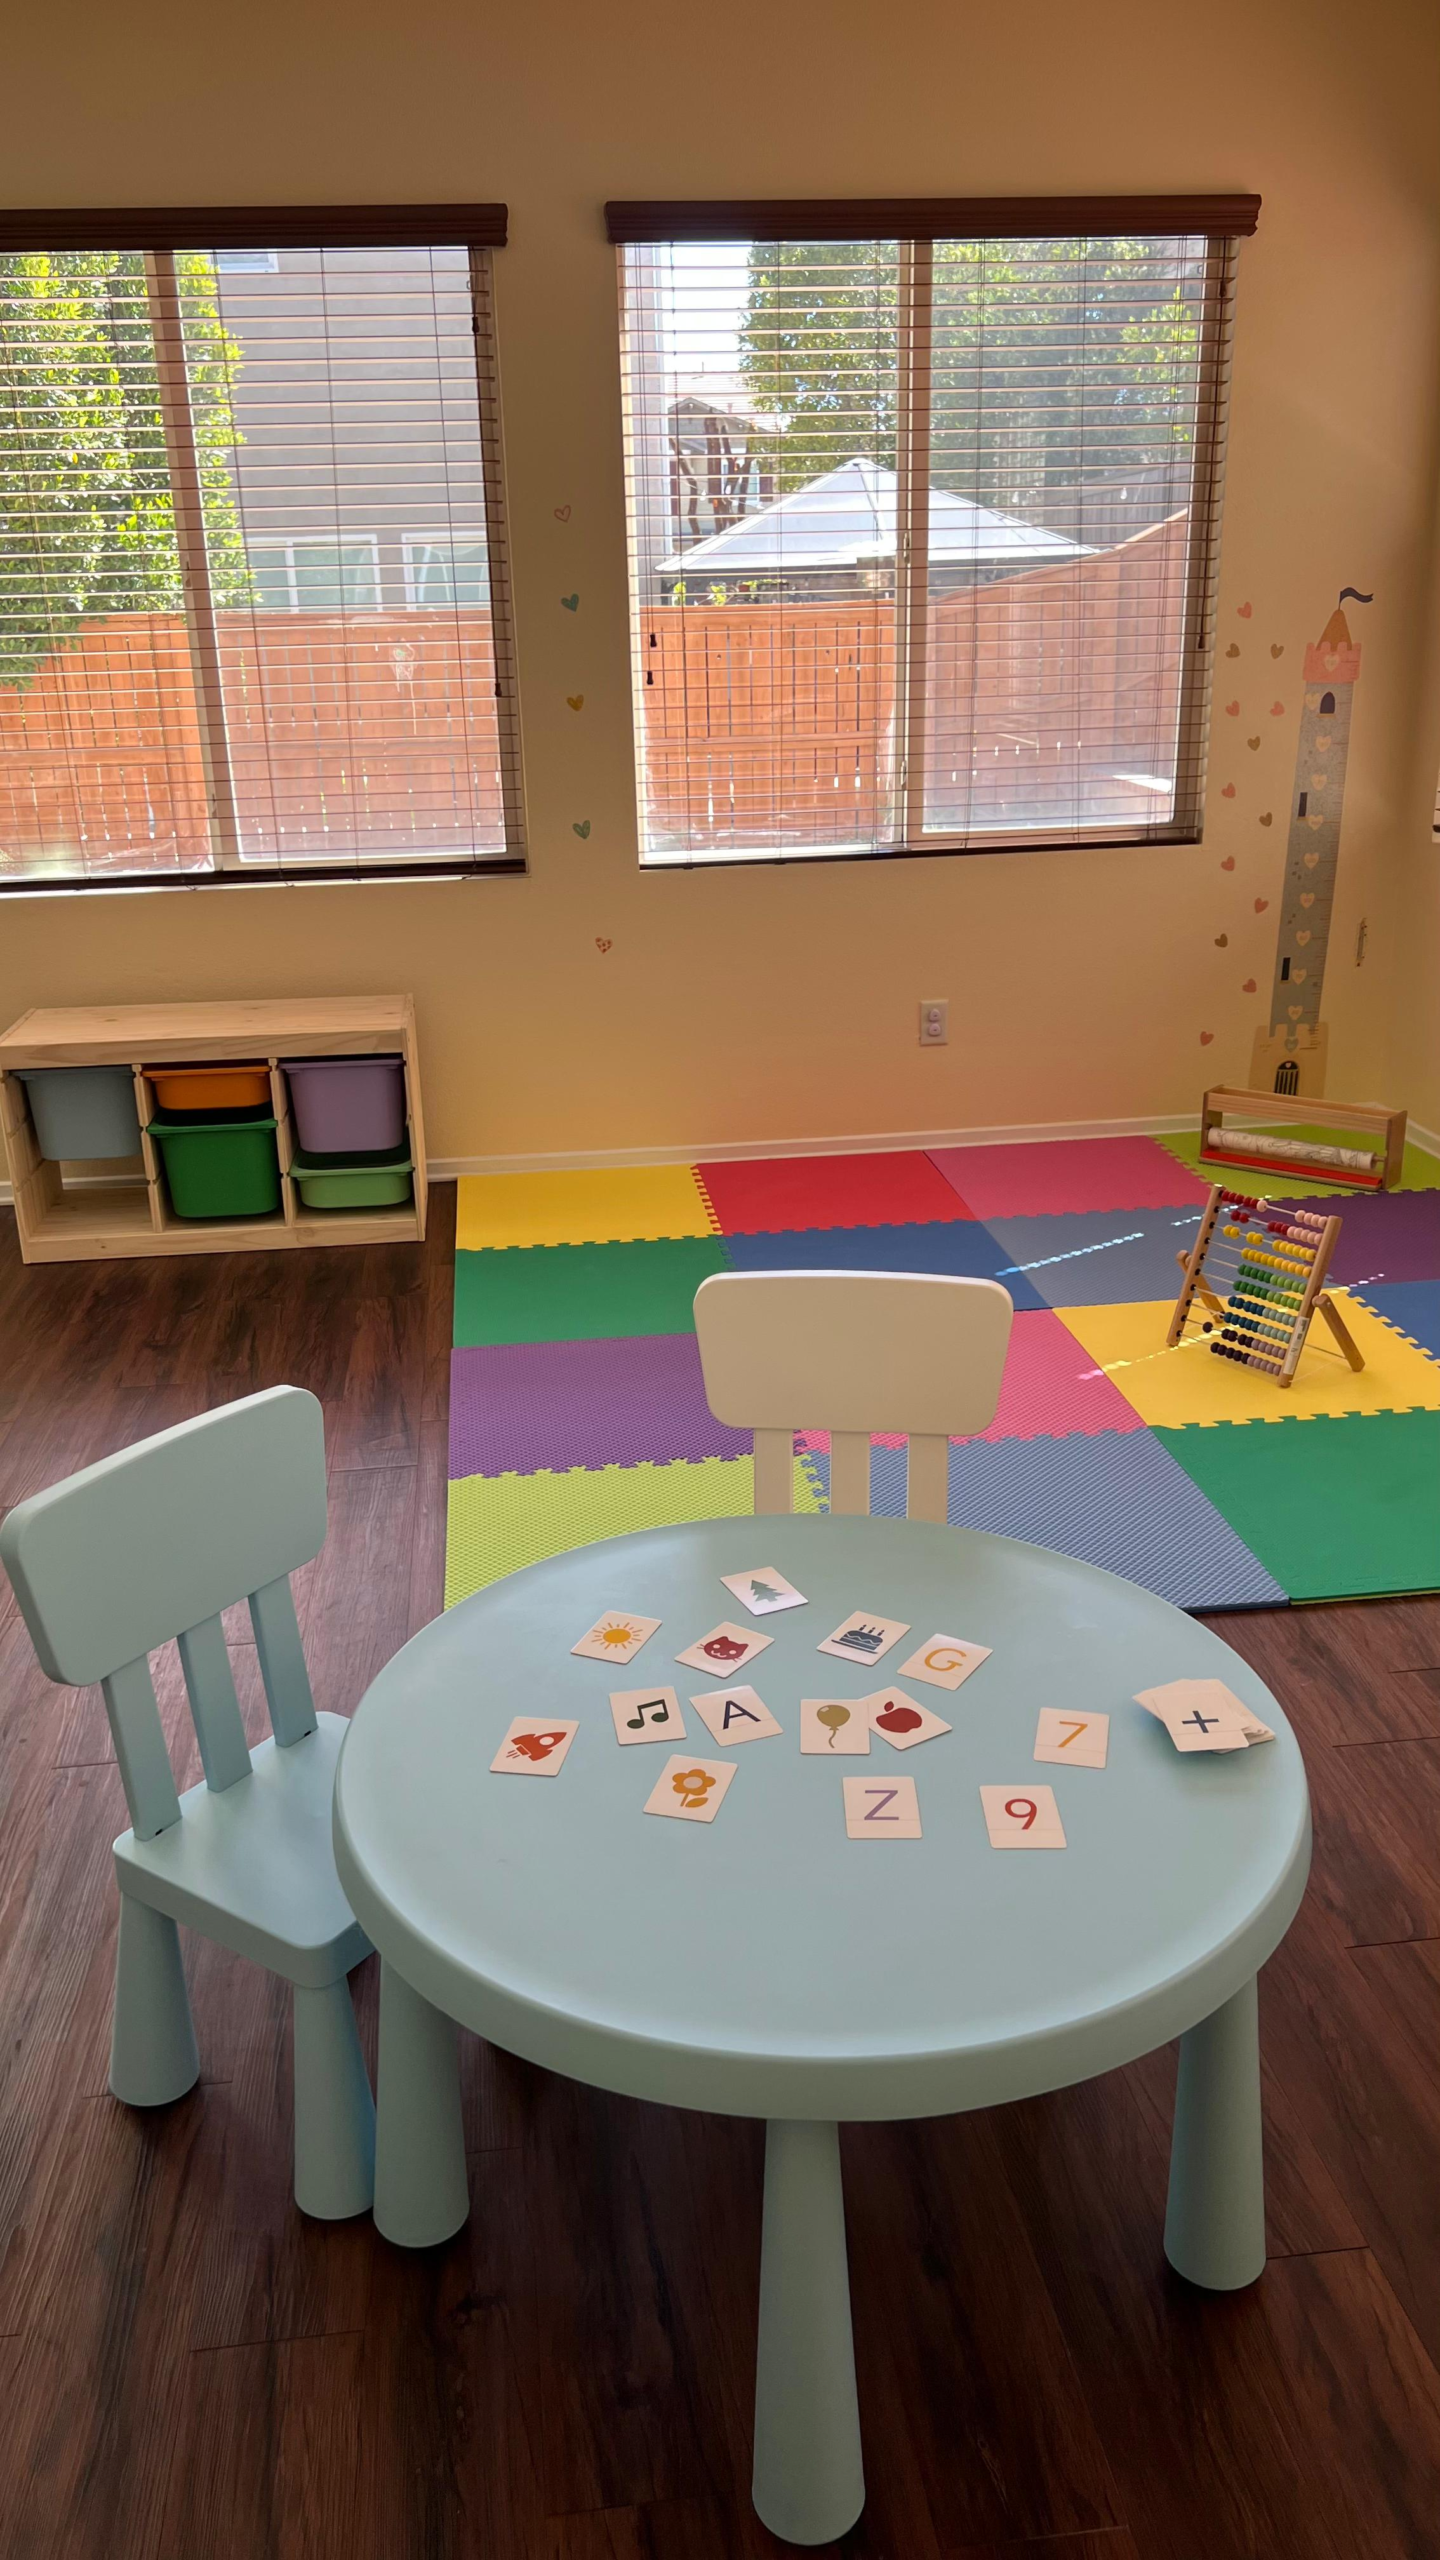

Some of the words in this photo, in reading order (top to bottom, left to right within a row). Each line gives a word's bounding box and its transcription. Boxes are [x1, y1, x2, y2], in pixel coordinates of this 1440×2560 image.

[924, 1647, 968, 1672] G
[722, 1699, 762, 1730] A
[1181, 1710, 1220, 1734] +
[1057, 1720, 1088, 1748] 7
[863, 1789, 900, 1821] Z
[1004, 1798, 1038, 1831] 9
